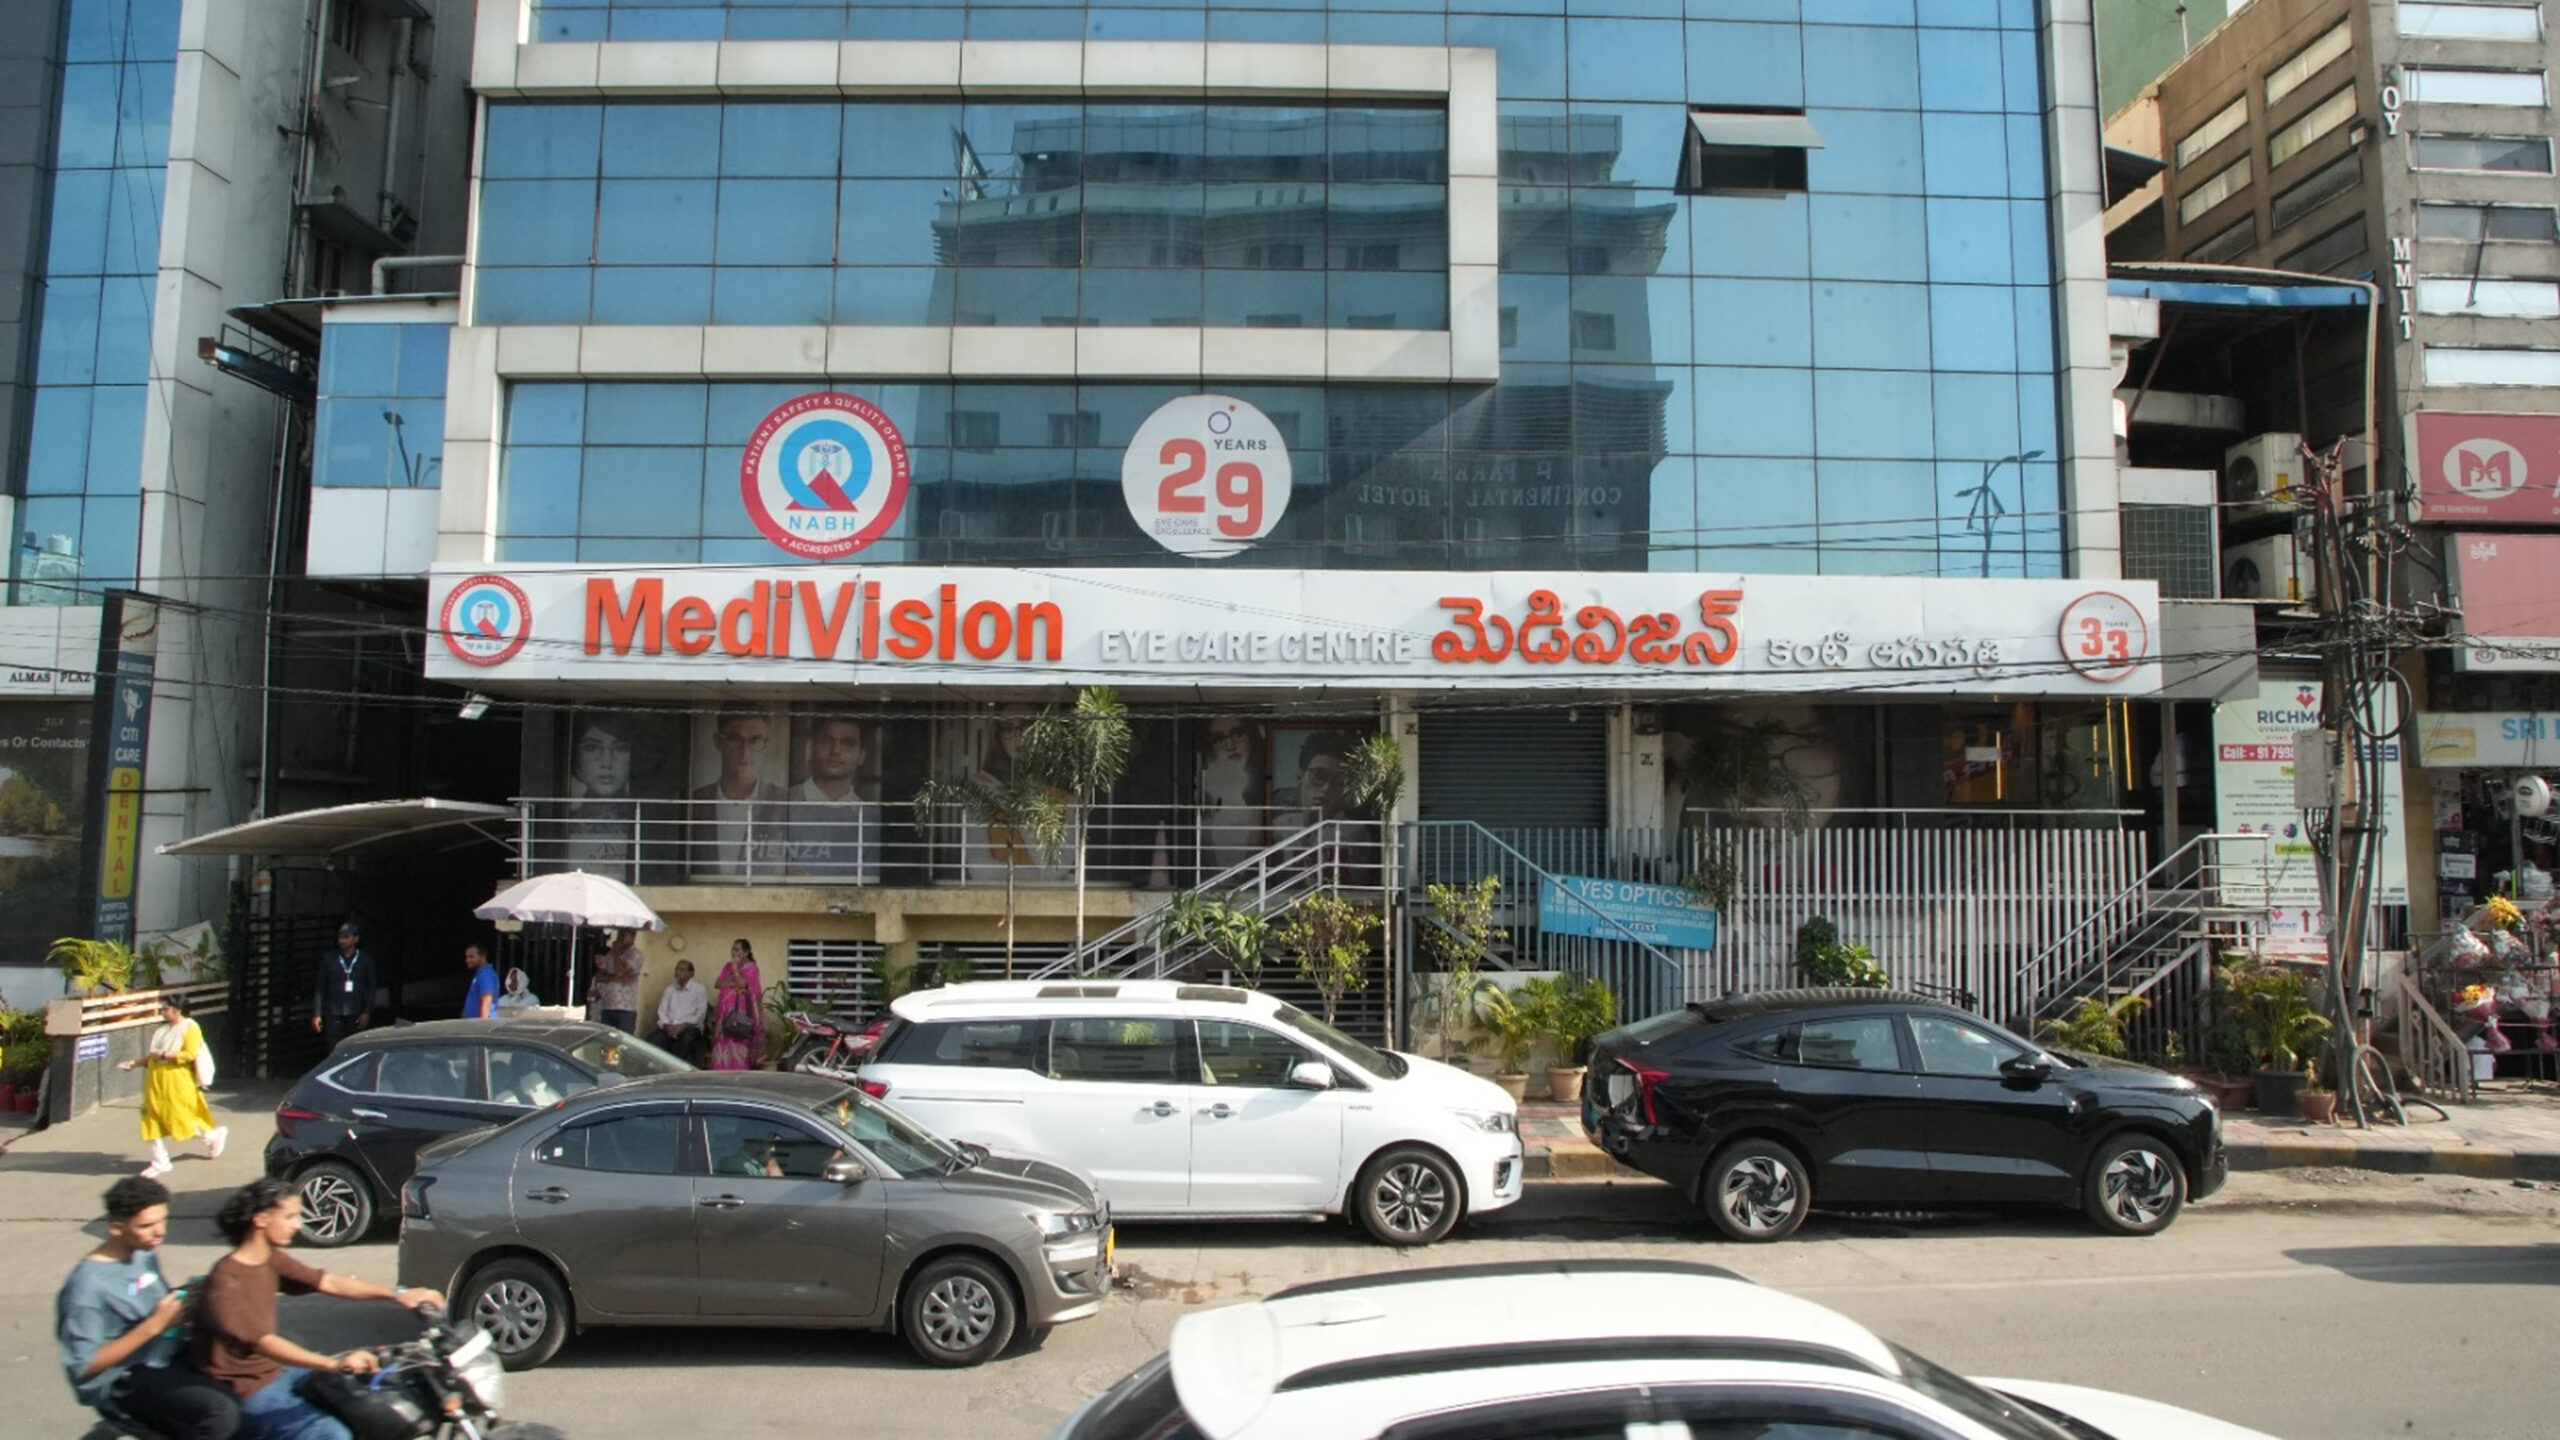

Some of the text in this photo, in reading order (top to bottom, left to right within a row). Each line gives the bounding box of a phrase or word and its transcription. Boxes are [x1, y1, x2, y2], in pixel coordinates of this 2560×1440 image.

[746, 396, 907, 478] PATIENT SAFETY & QUALITY OF CARE
[1214, 439, 1268, 451] YEARS
[1158, 438, 1264, 537] 29
[788, 515, 855, 531] NABH
[788, 538, 852, 555] ACCREDITED
[584, 576, 1063, 662] MediVision
[1431, 588, 1744, 665] మెడివిజన్
[1101, 629, 1413, 663] EYE CARE CENTRE
[9, 671, 96, 683] ALMAS PLAZ
[120, 727, 140, 742] CITI
[2502, 717, 2546, 741] SRI
[12, 737, 28, 749] Or
[115, 748, 141, 762] CARE
[112, 772, 132, 893] DENTAL
[1579, 880, 1614, 900] YES
[1620, 884, 1686, 909] OPTICS
